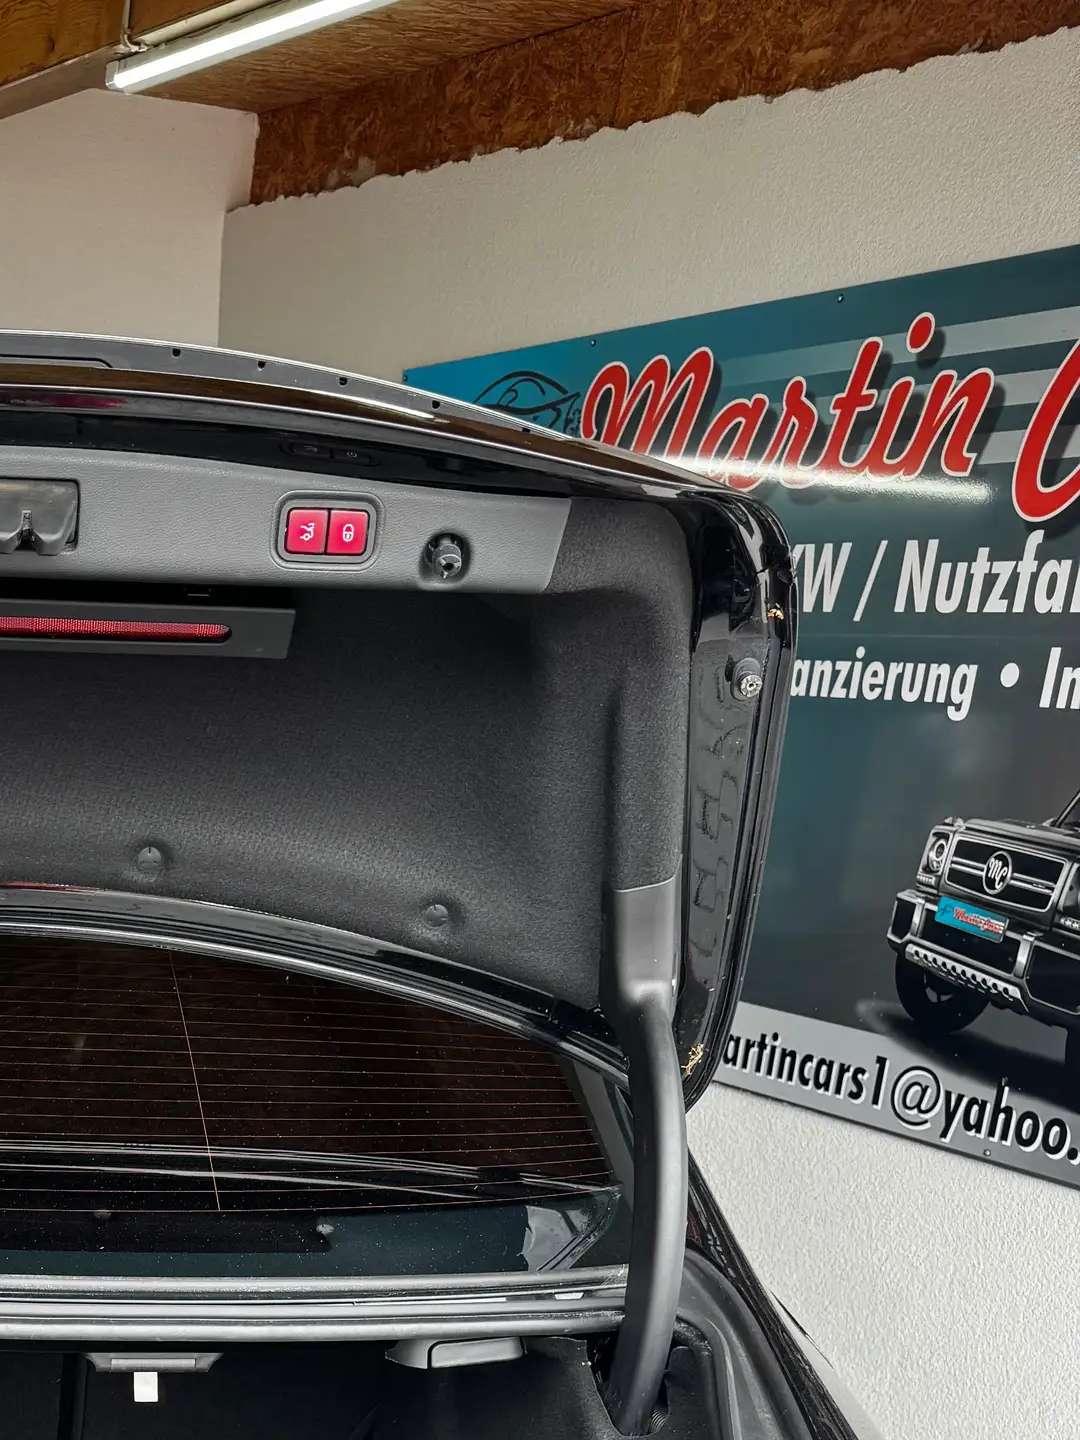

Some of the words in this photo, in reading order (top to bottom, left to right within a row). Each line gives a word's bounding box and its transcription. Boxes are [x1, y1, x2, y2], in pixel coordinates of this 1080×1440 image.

[581, 312, 994, 490] Martin
[792, 542, 852, 613] W
[894, 529, 1080, 613] Nutzfa
